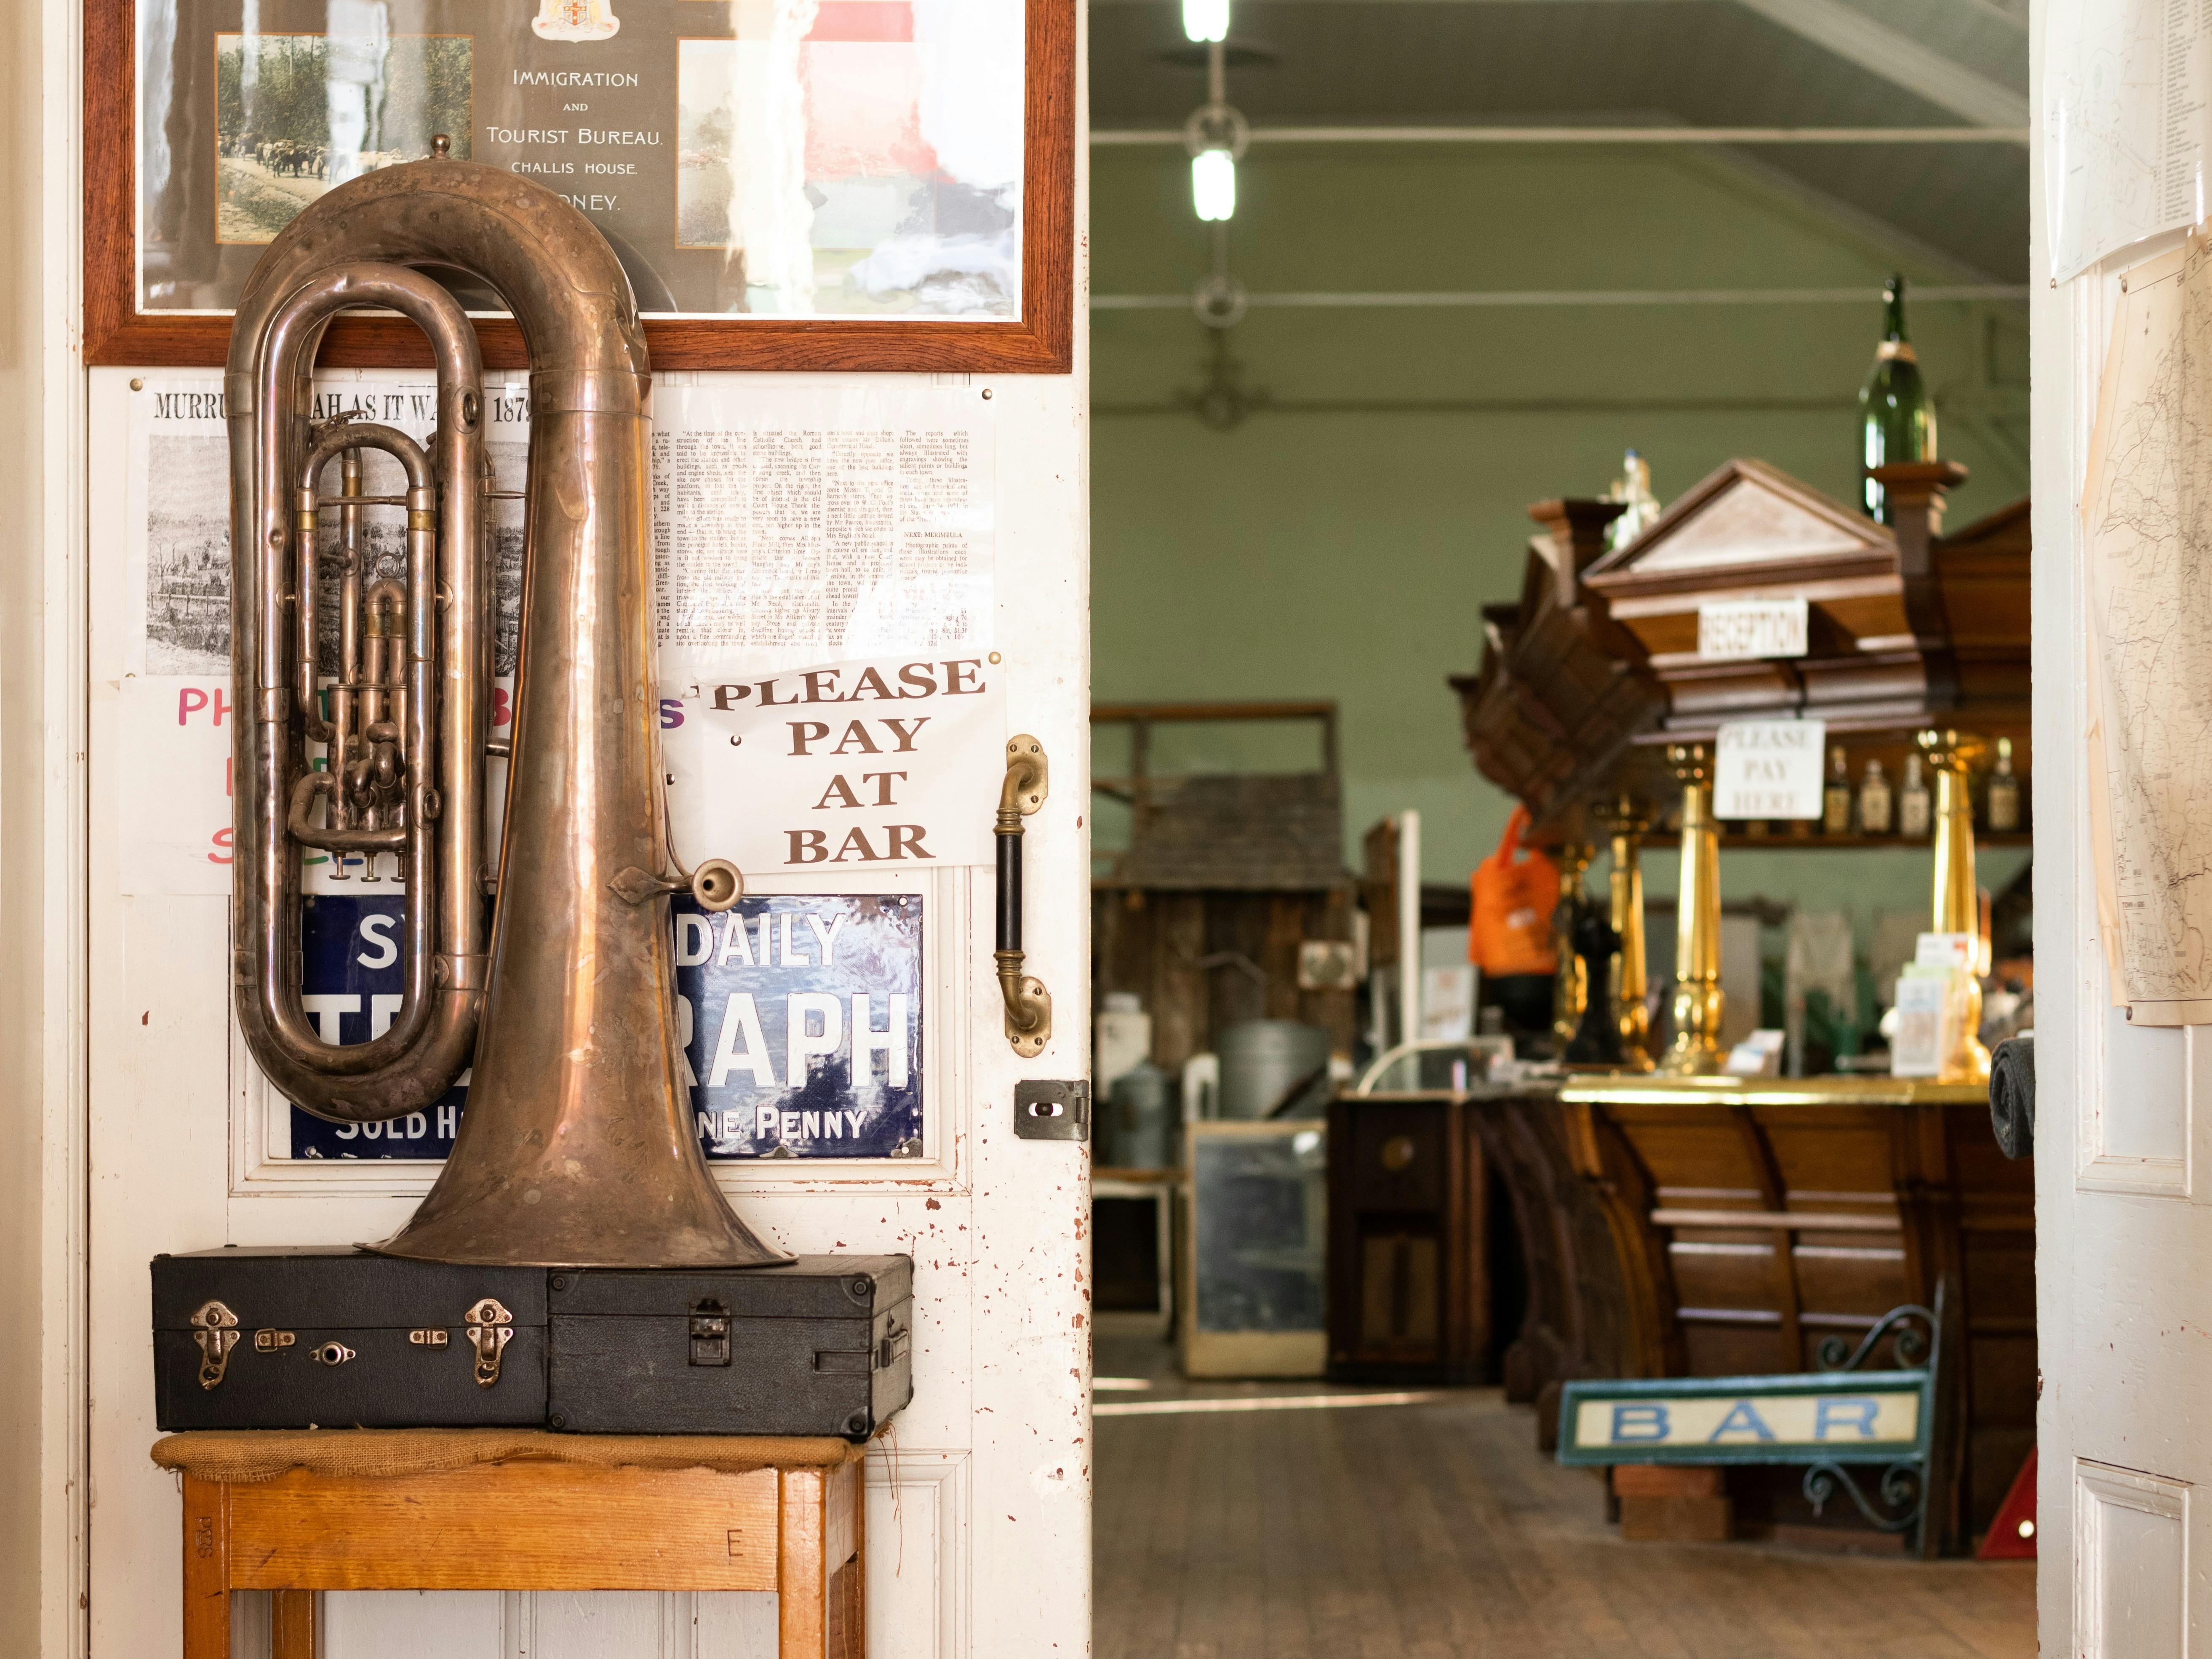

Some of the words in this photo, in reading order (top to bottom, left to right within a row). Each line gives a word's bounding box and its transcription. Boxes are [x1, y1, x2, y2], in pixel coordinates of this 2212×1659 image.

[513, 70, 638, 87] IMMIGRATION
[563, 103, 588, 111] AND
[486, 127, 568, 144] TOURIST
[578, 129, 663, 145] BUREAU.
[511, 162, 574, 174] CHALLIS
[383, 395, 404, 420] IT
[710, 659, 986, 711] PLEASE
[786, 717, 931, 757] PAY
[1743, 757, 1788, 780] PAY
[811, 771, 907, 810] AT
[784, 824, 936, 864] BAR
[676, 912, 846, 967] DAILY
[699, 1111, 741, 1139] NE
[756, 1105, 867, 1139] PENNY
[1611, 1398, 1880, 1444] BAR
[727, 1529, 743, 1556] E
